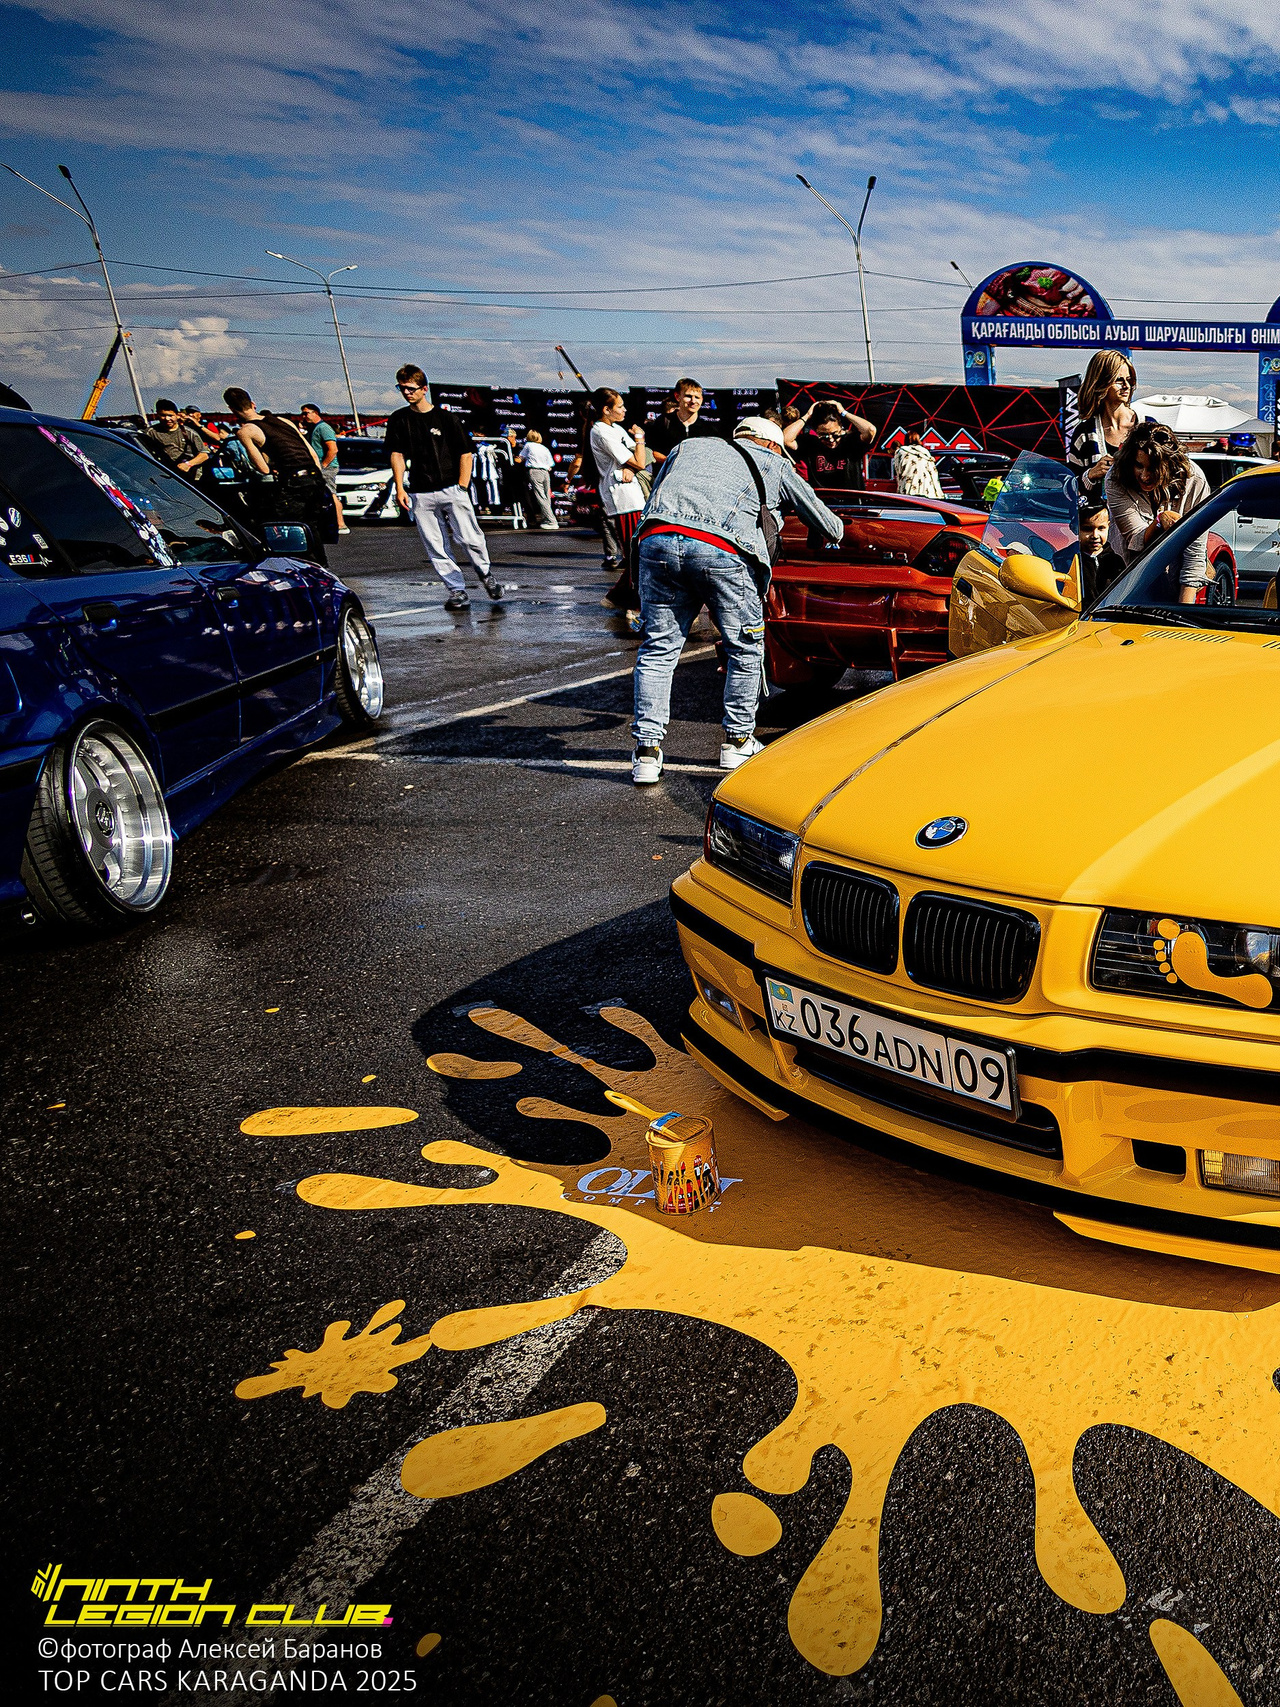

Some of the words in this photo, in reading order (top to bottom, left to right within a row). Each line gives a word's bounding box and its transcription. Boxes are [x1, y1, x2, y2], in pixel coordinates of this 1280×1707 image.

[971, 321, 1045, 341] ҚАРАҒАНДЫ
[1047, 323, 1100, 341] ОБЛЫСЫ
[1104, 325, 1140, 342] АУЫЛ
[1144, 325, 1246, 344] ШАРУАШЫЛЫҒЫ
[9, 554, 29, 563] E36
[774, 1009, 799, 1033] KZ
[800, 996, 945, 1085] 036ADN
[953, 1046, 1005, 1101] 09
